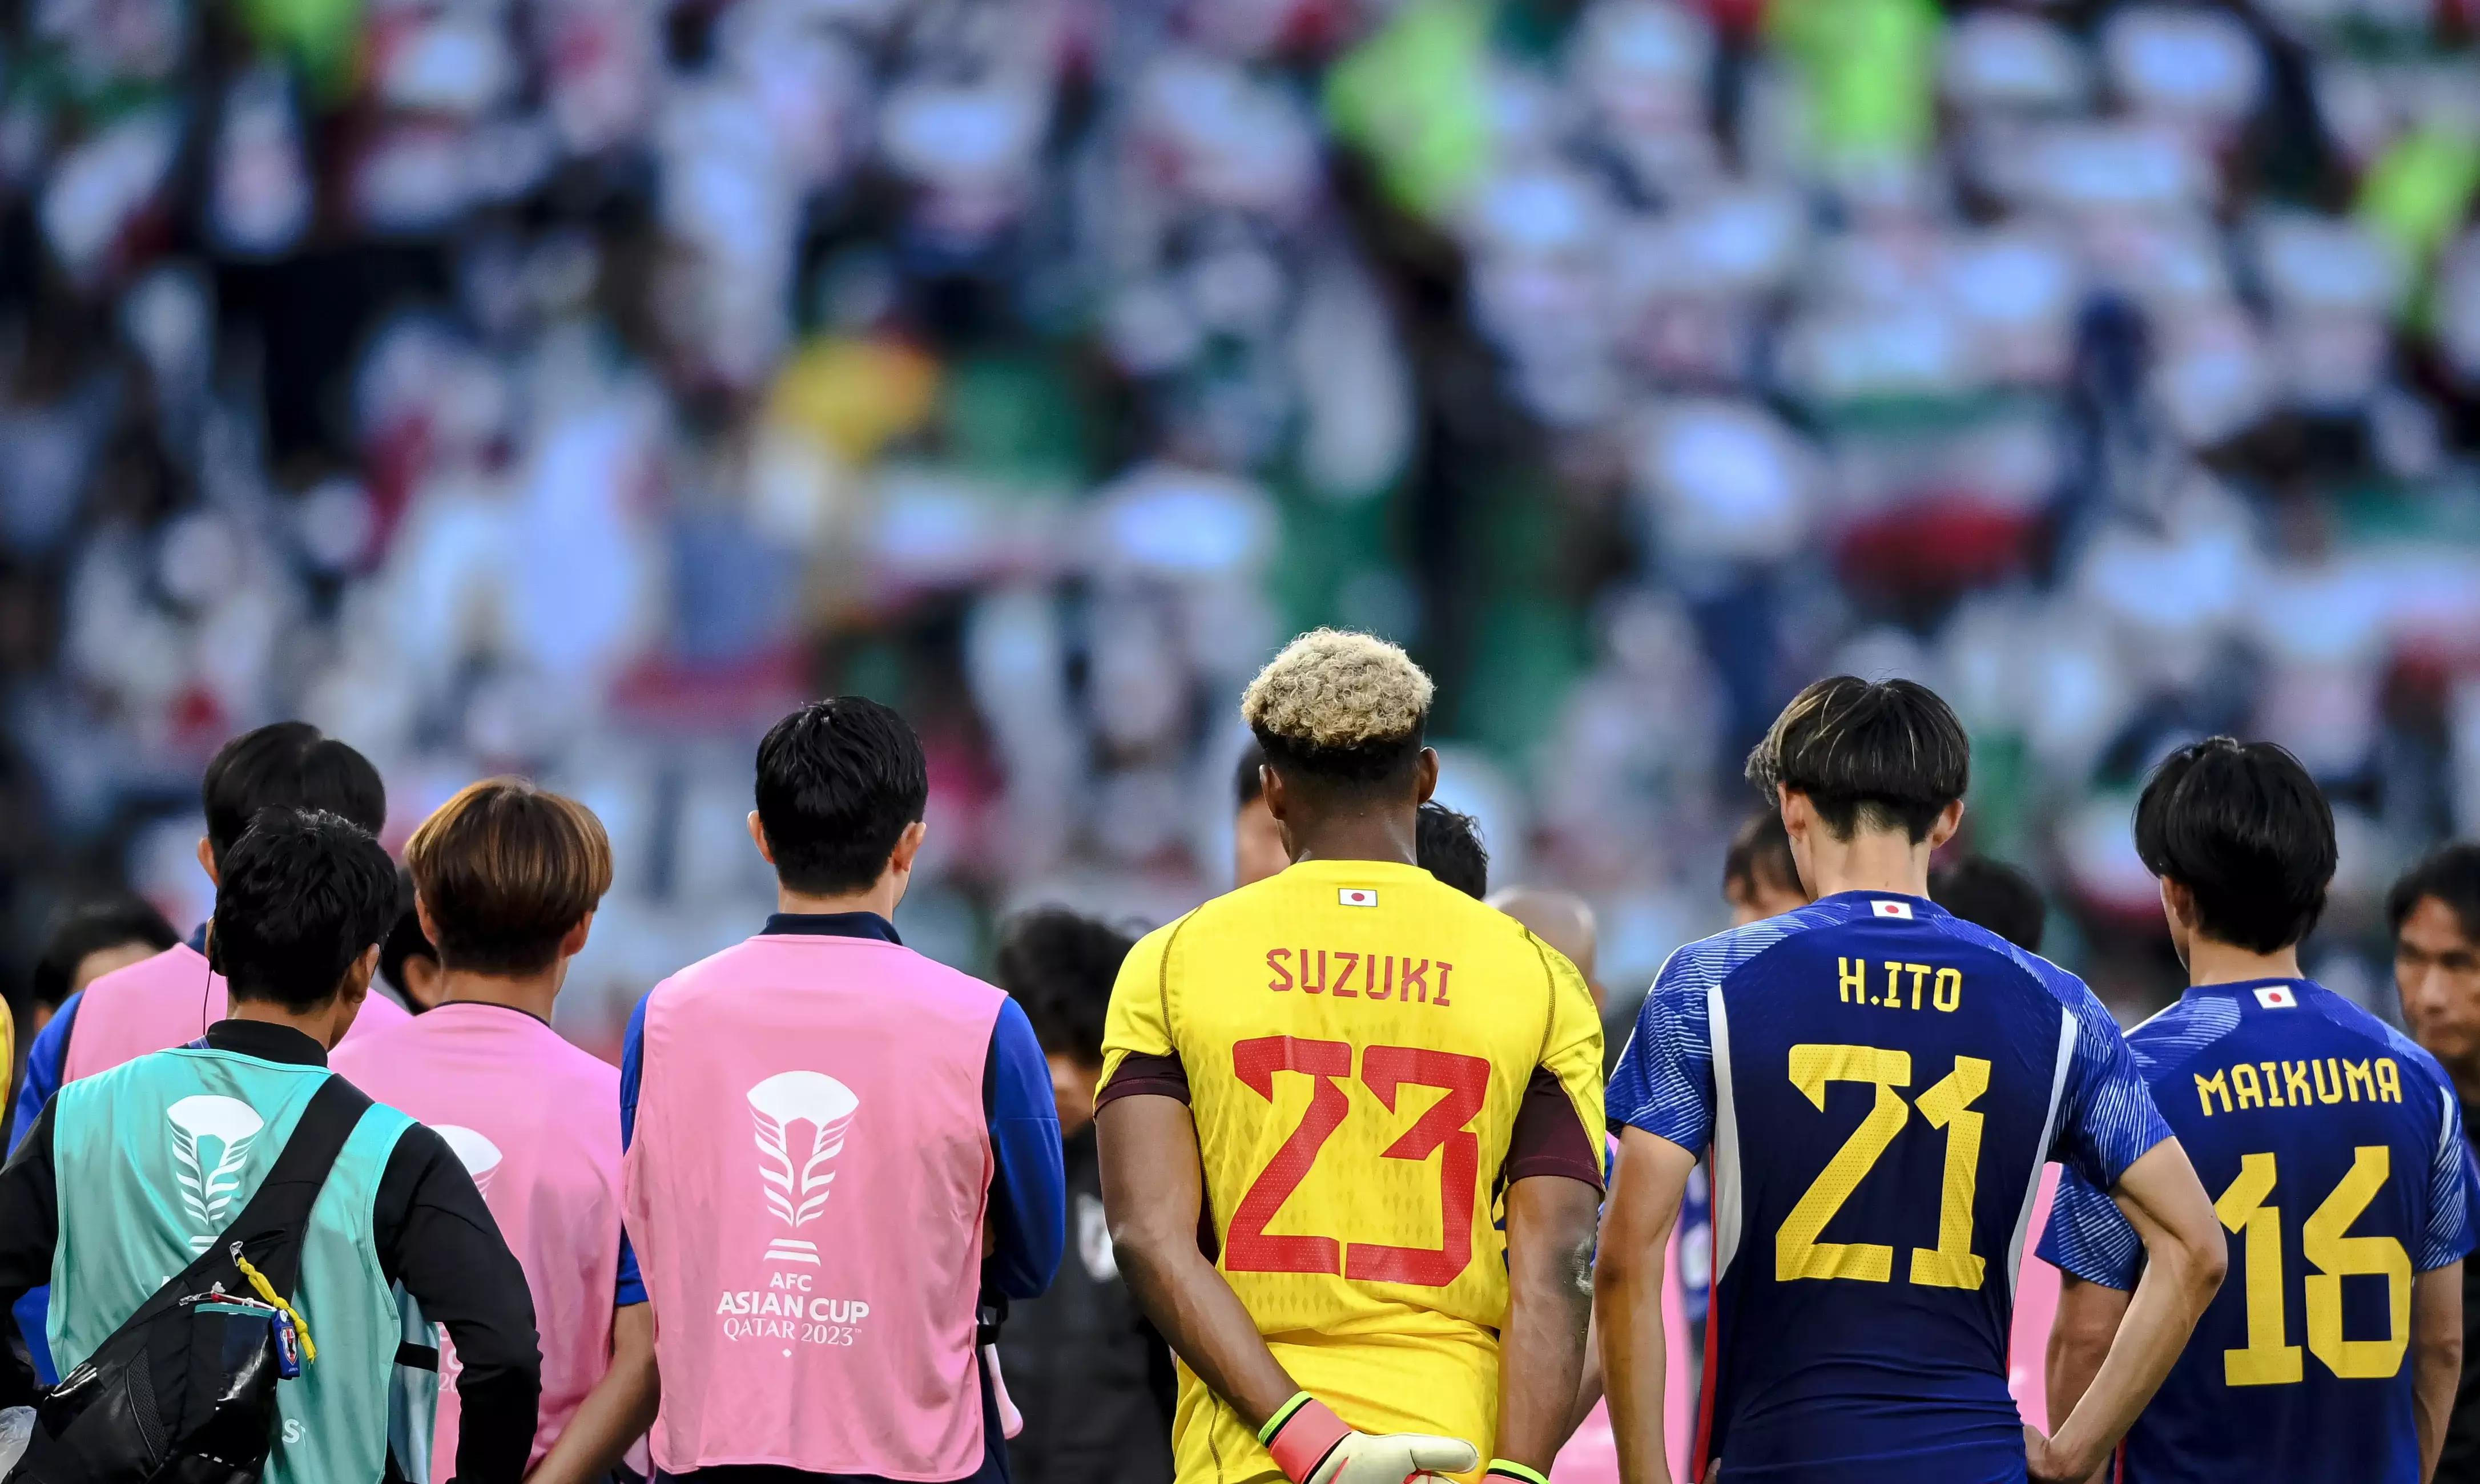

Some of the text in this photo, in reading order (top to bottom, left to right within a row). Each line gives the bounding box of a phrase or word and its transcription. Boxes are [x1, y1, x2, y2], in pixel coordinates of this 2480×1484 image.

[1268, 949, 1452, 1005] SUZUKI
[1841, 958, 1962, 1011] H.ITO
[2196, 1059, 2401, 1115] MAIKUMA
[1225, 1036, 1491, 1287] 23
[1776, 1044, 1991, 1290] 21
[769, 1272, 812, 1292] AFC
[2216, 1146, 2411, 1386] 16
[716, 1291, 869, 1324] ASIAN CUP
[723, 1317, 795, 1341] QATAR
